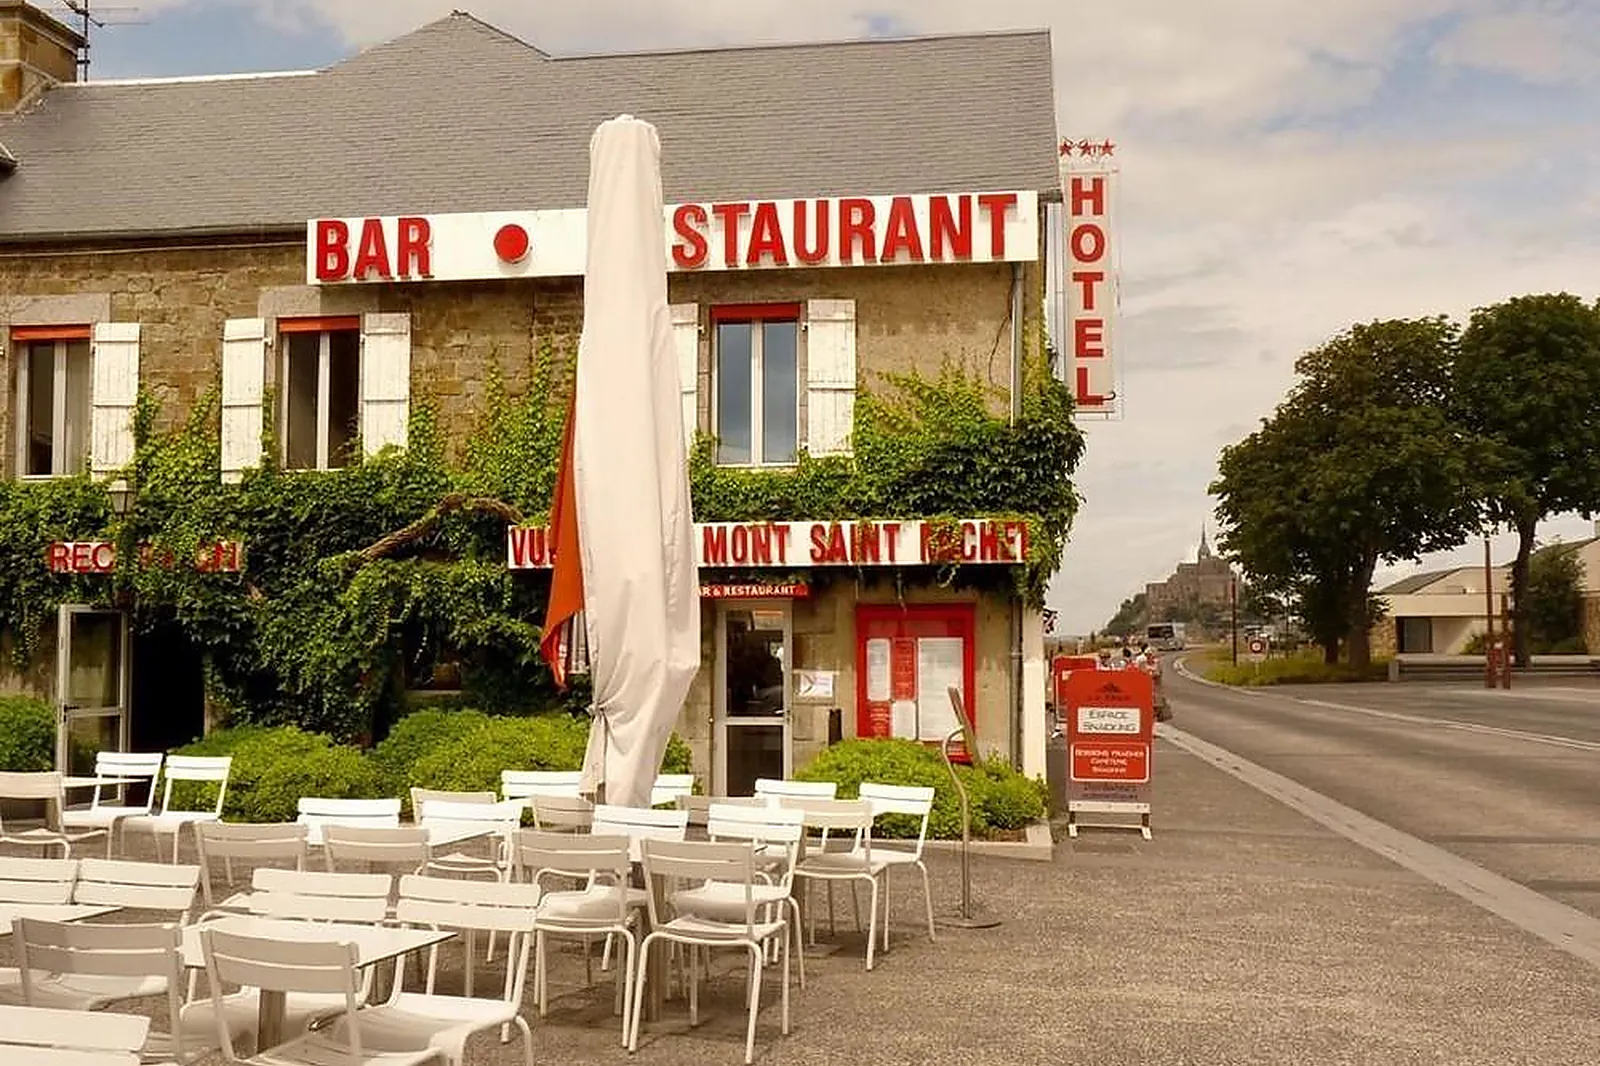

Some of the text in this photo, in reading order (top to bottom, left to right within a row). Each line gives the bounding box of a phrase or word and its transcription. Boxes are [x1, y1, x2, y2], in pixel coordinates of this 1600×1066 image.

[316, 193, 1018, 282] BAR STAURANT
[1070, 178, 1105, 406] HOTEL
[511, 521, 1031, 566] VU MONT SAINT MCHEL
[724, 584, 796, 597] RESTAURANT
